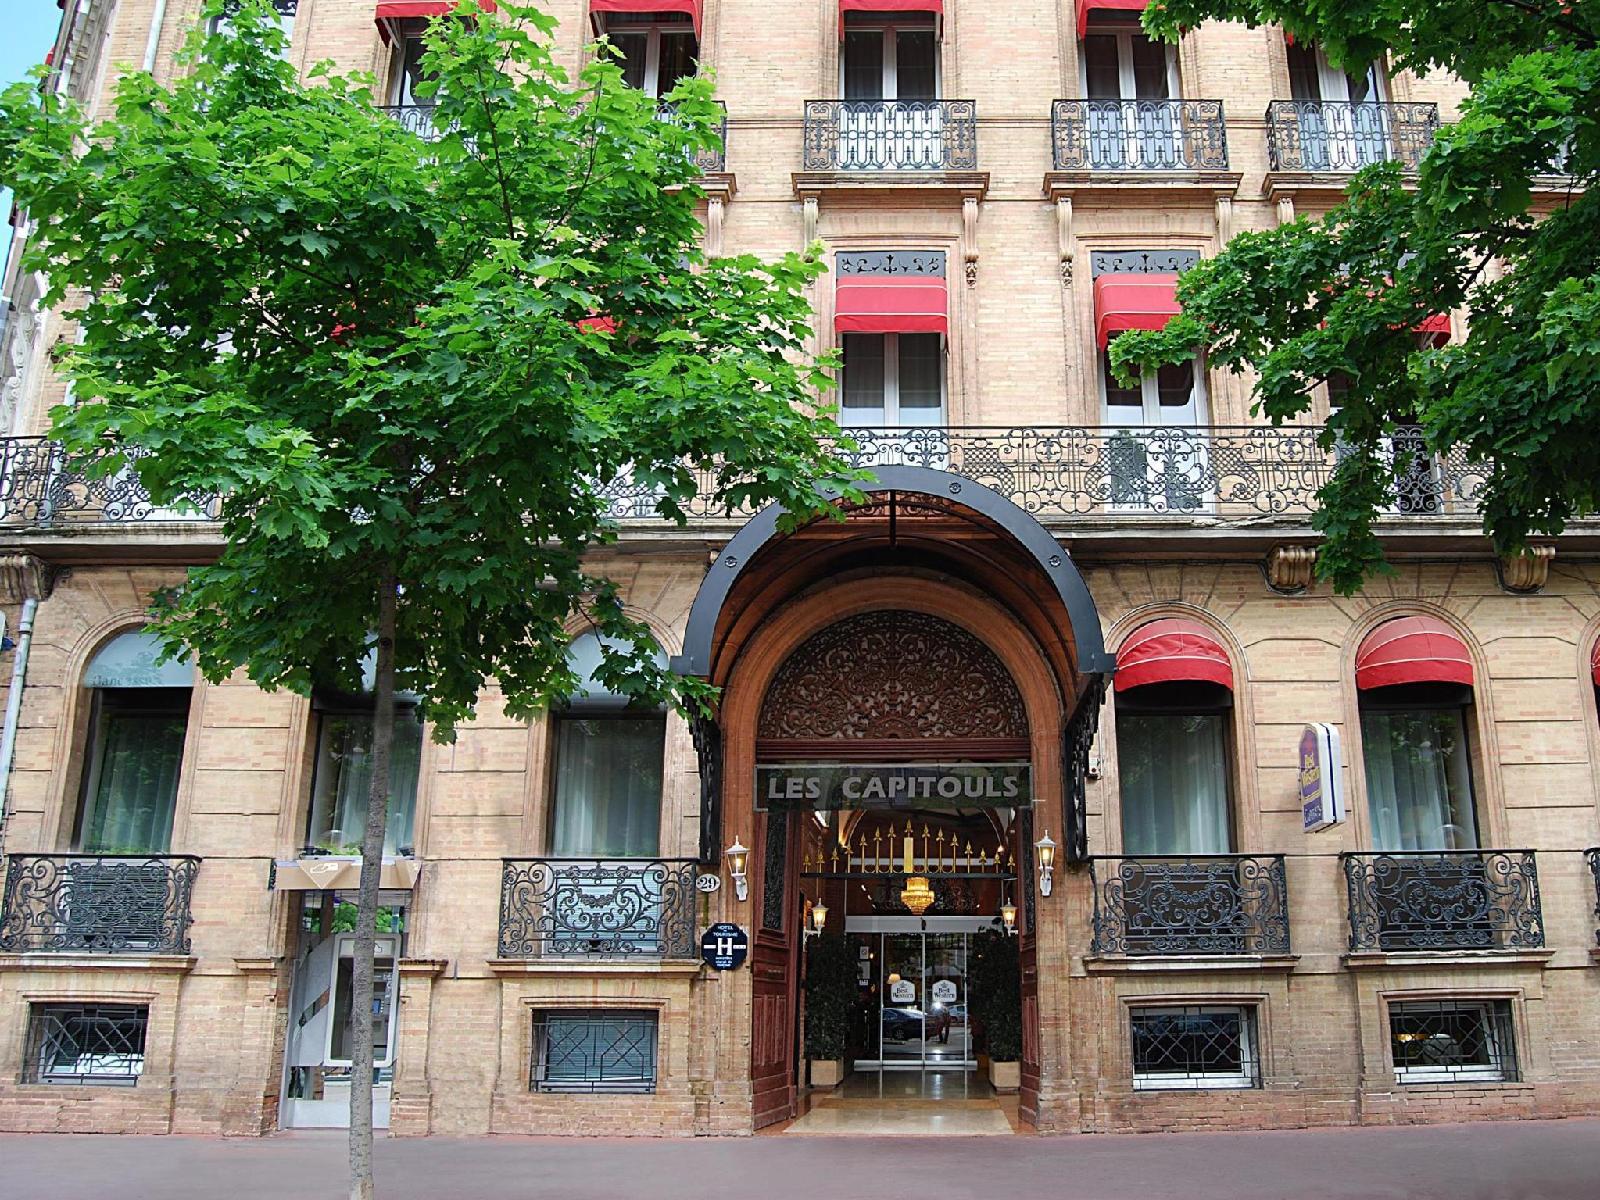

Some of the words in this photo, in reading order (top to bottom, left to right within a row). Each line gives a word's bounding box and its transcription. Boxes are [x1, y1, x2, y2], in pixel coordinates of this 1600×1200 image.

[768, 777, 820, 799] LES
[842, 776, 1019, 798] CAPITOULS
[700, 876, 716, 889] 29
[717, 938, 733, 955] H
